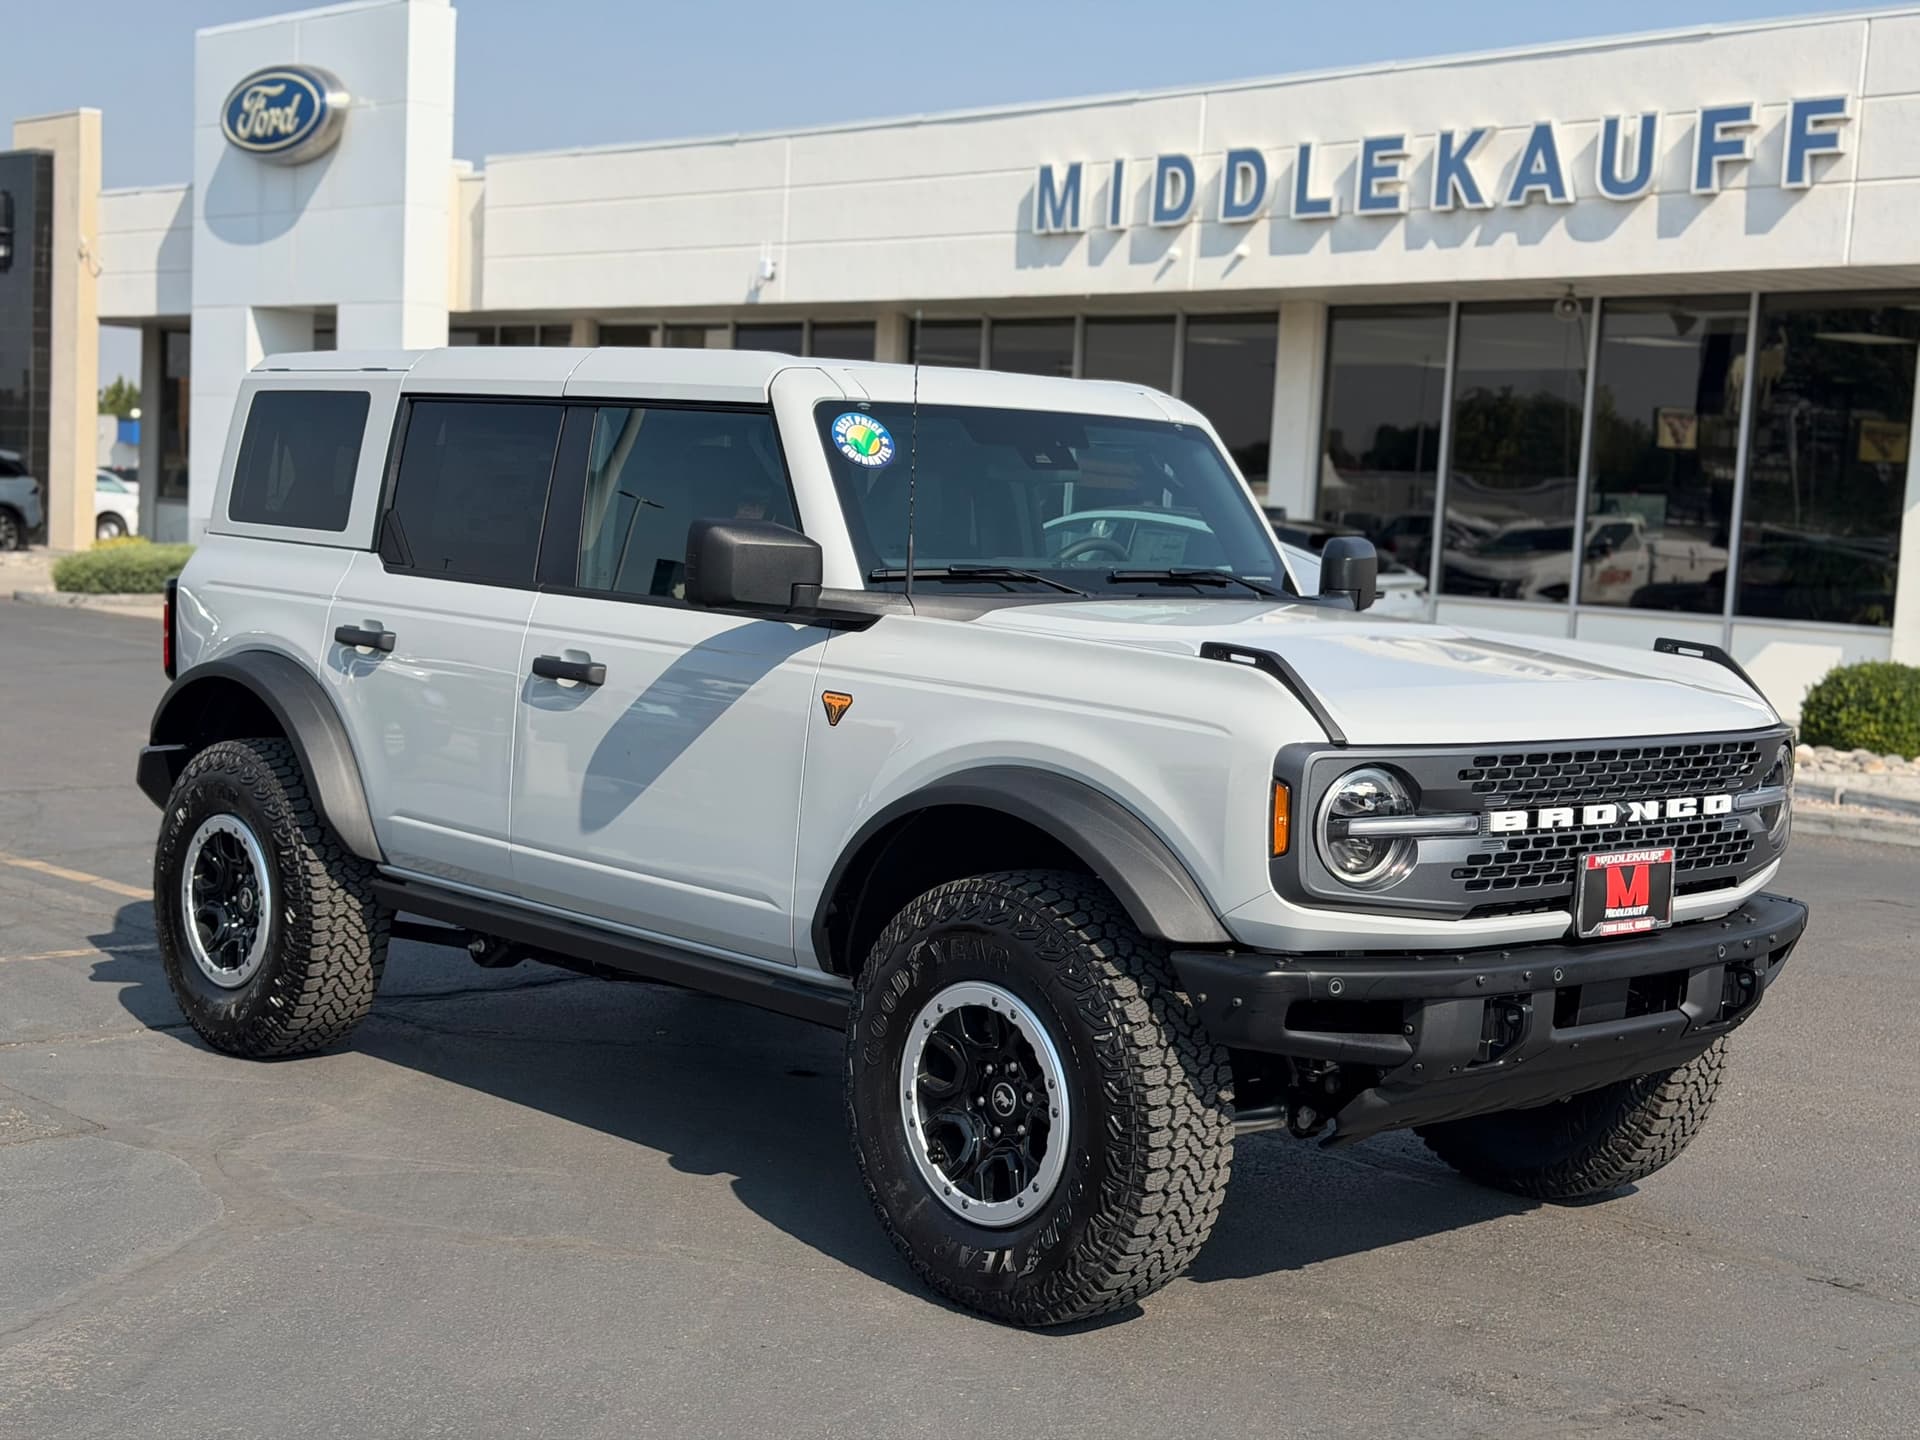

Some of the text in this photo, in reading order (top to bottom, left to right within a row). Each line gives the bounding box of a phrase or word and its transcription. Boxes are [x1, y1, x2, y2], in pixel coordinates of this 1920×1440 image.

[237, 83, 302, 139] Ford
[1034, 96, 1850, 235] MIDDLEKAUFF
[835, 415, 884, 436] BEST PRICE
[1489, 794, 1733, 833] BRONCO
[1594, 850, 1665, 867] MIDDLEKAUFF
[1606, 864, 1649, 908] M
